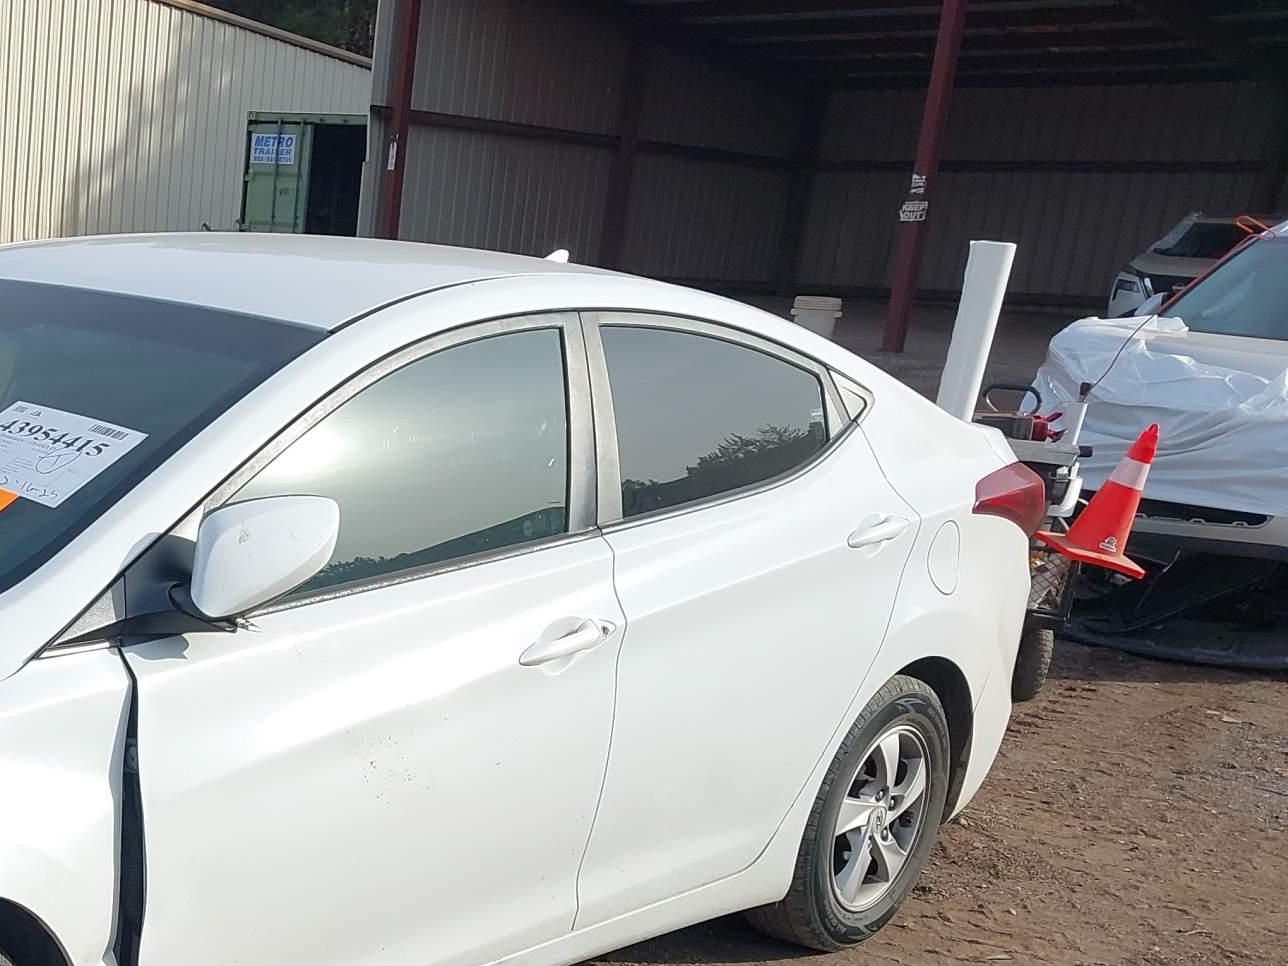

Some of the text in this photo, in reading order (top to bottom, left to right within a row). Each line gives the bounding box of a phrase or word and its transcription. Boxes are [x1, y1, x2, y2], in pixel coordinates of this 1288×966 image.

[254, 135, 294, 147] METRO
[253, 147, 292, 156] TRAIER
[902, 204, 925, 212] KEEP
[903, 211, 922, 220] OUT
[0, 419, 111, 457] 43954415
